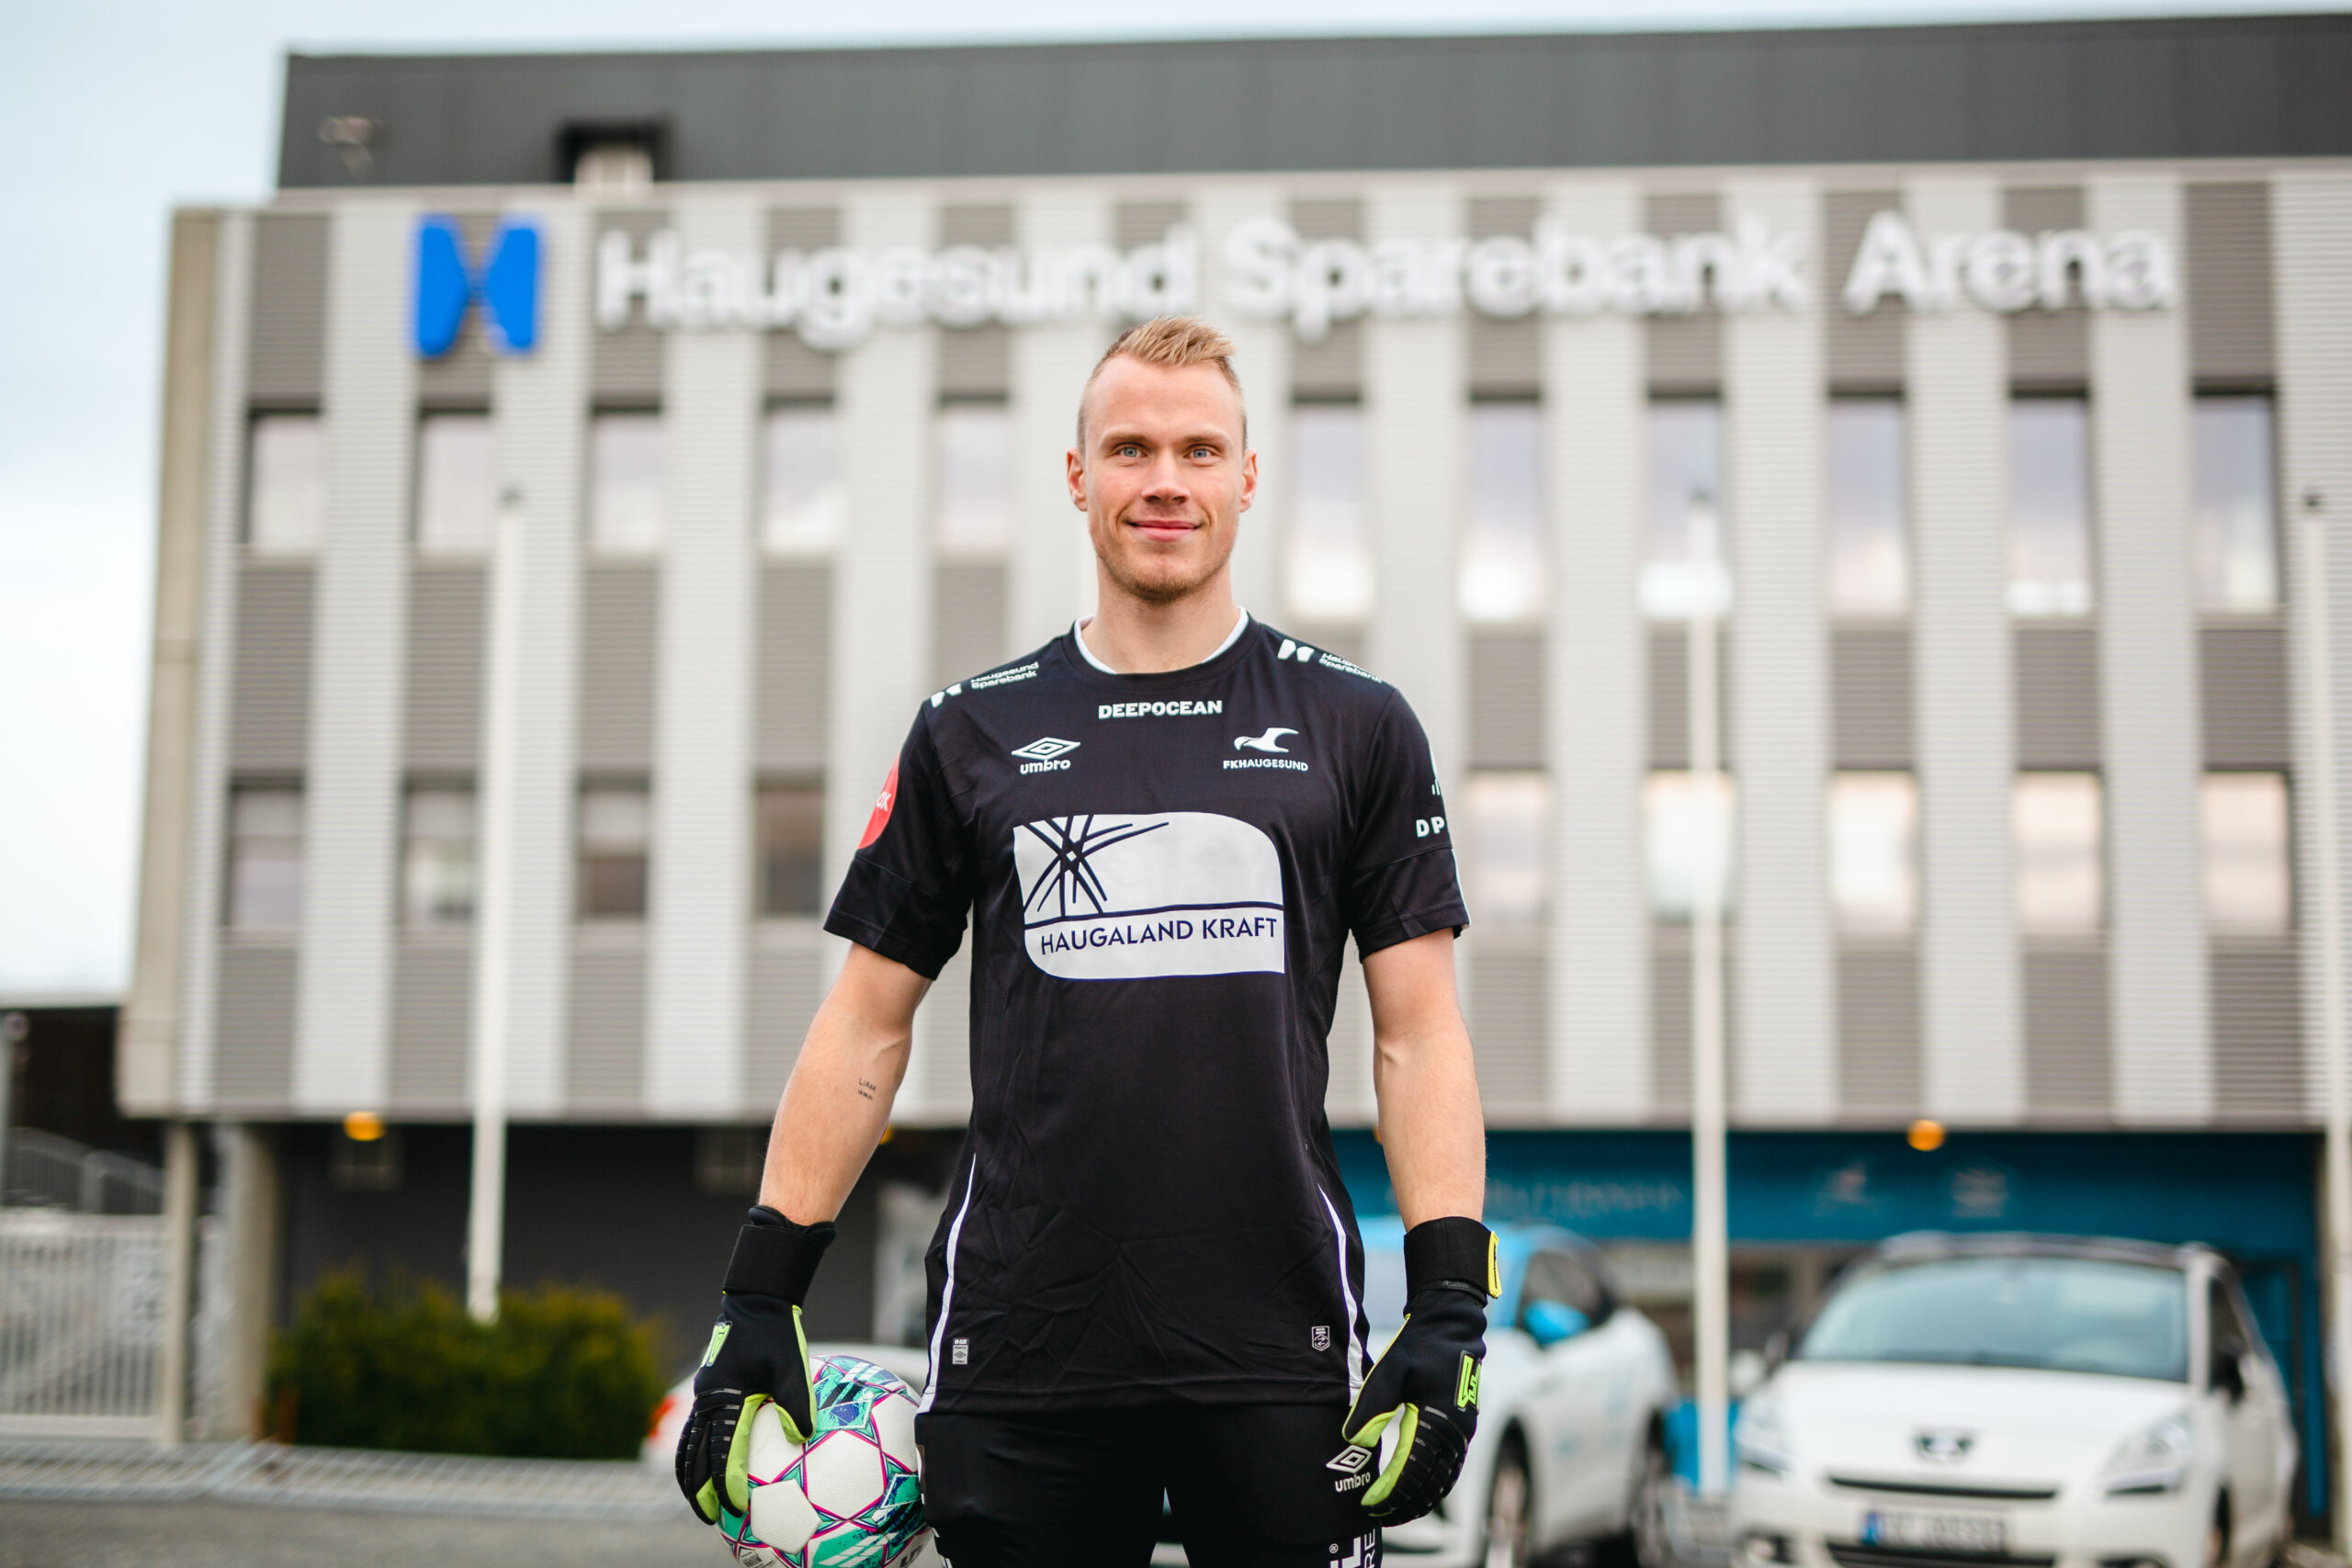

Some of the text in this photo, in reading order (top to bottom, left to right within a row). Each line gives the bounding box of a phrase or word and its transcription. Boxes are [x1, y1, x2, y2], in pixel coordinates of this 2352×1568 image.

[595, 209, 2179, 351] Haugesund Sparebank Arena
[970, 661, 1039, 683] Haugesund
[971, 670, 1037, 689] Sparebank
[1098, 700, 1222, 719] DEEPOCEAN
[1020, 759, 1071, 774] umbro
[1041, 917, 1277, 955] HAUGALAND KRAFT
[1334, 1472, 1372, 1493] umbro
